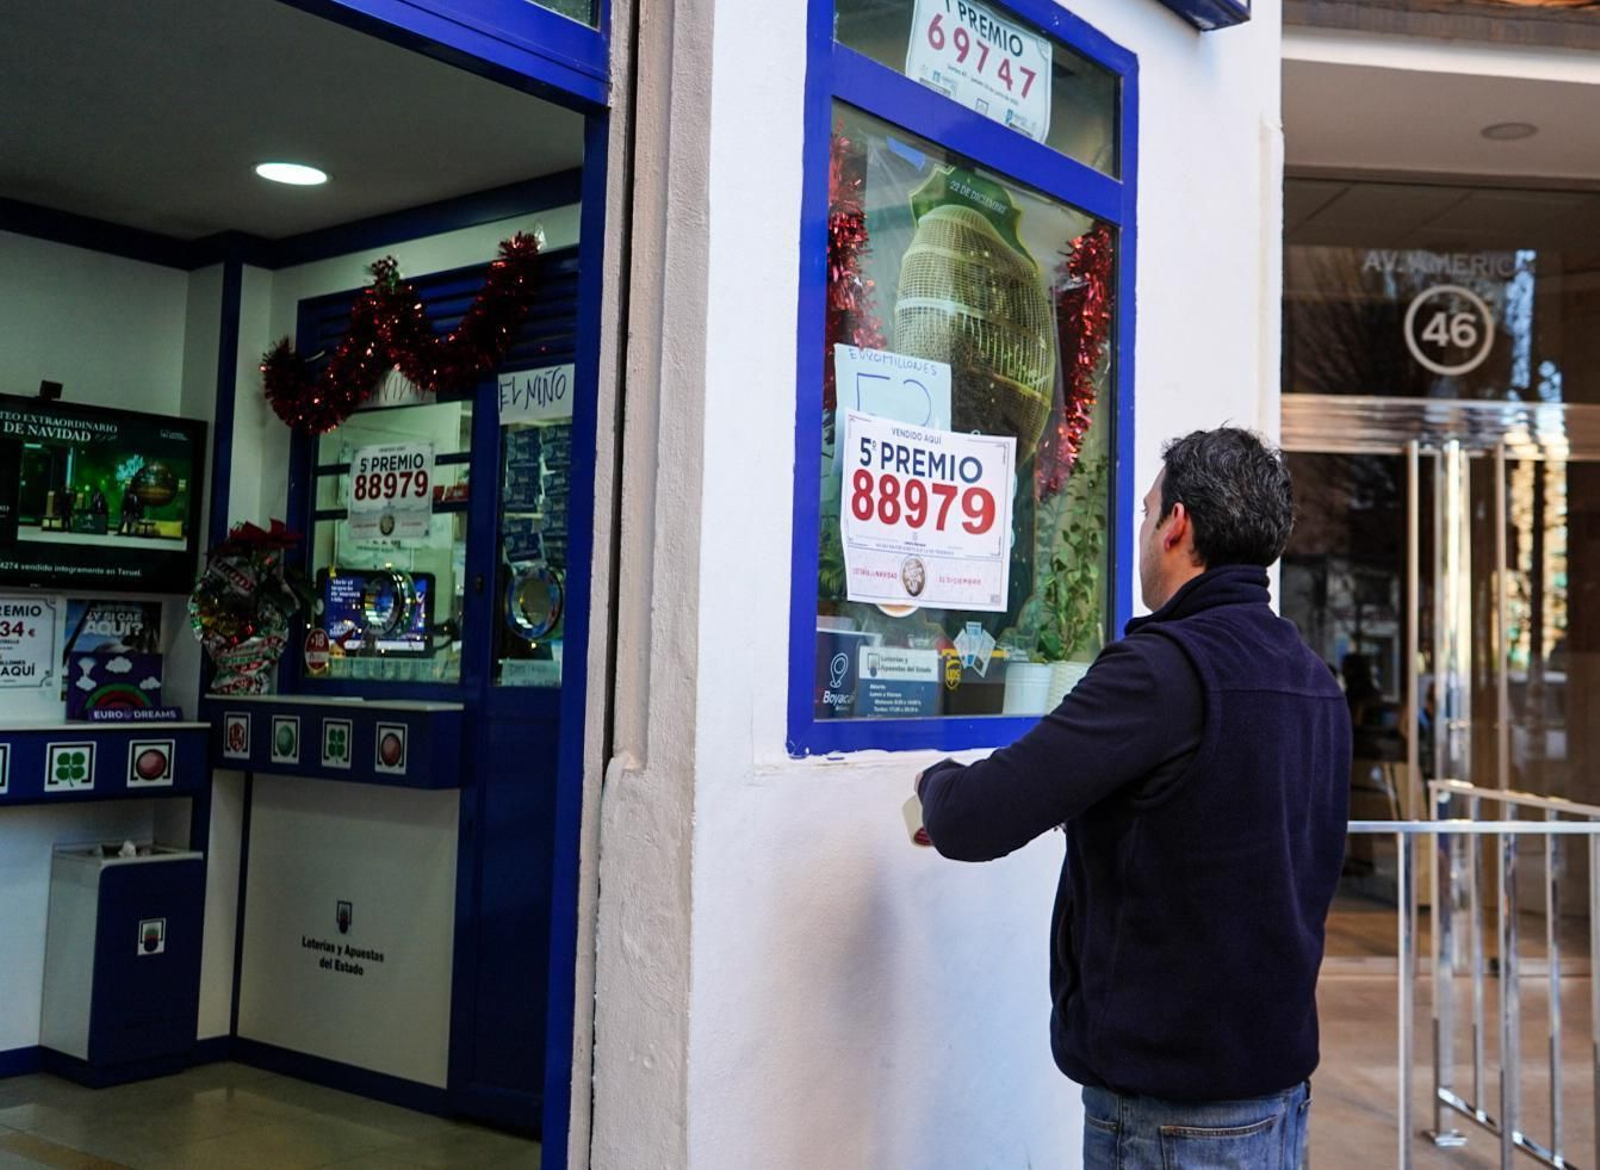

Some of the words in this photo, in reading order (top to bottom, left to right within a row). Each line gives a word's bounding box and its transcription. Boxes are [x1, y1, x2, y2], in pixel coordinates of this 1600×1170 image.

[958, 1, 1023, 57] PREMIO
[928, 13, 1037, 99] 69747
[949, 180, 960, 192] 22
[959, 184, 971, 198] DE
[970, 190, 1008, 215] DICIEMBRE
[1421, 312, 1478, 348] 46
[524, 367, 567, 410] NIÑO
[3, 420, 24, 435] DE
[27, 423, 91, 442] NAVIDAD
[23, 413, 118, 434] EXTRAORDINARIO
[892, 427, 922, 441] VENDIDO
[371, 453, 424, 472] PREMIO
[881, 441, 983, 483] PREMIO
[355, 470, 429, 501] 88979
[851, 468, 996, 535] 88979
[21, 562, 52, 572] vendido
[116, 612, 142, 621] CAE
[93, 710, 124, 720] EURO
[134, 709, 177, 719] DREAMS
[337, 944, 343, 957] y
[344, 944, 384, 963] Apuestas
[320, 956, 332, 969] del
[334, 958, 364, 976] Estado
